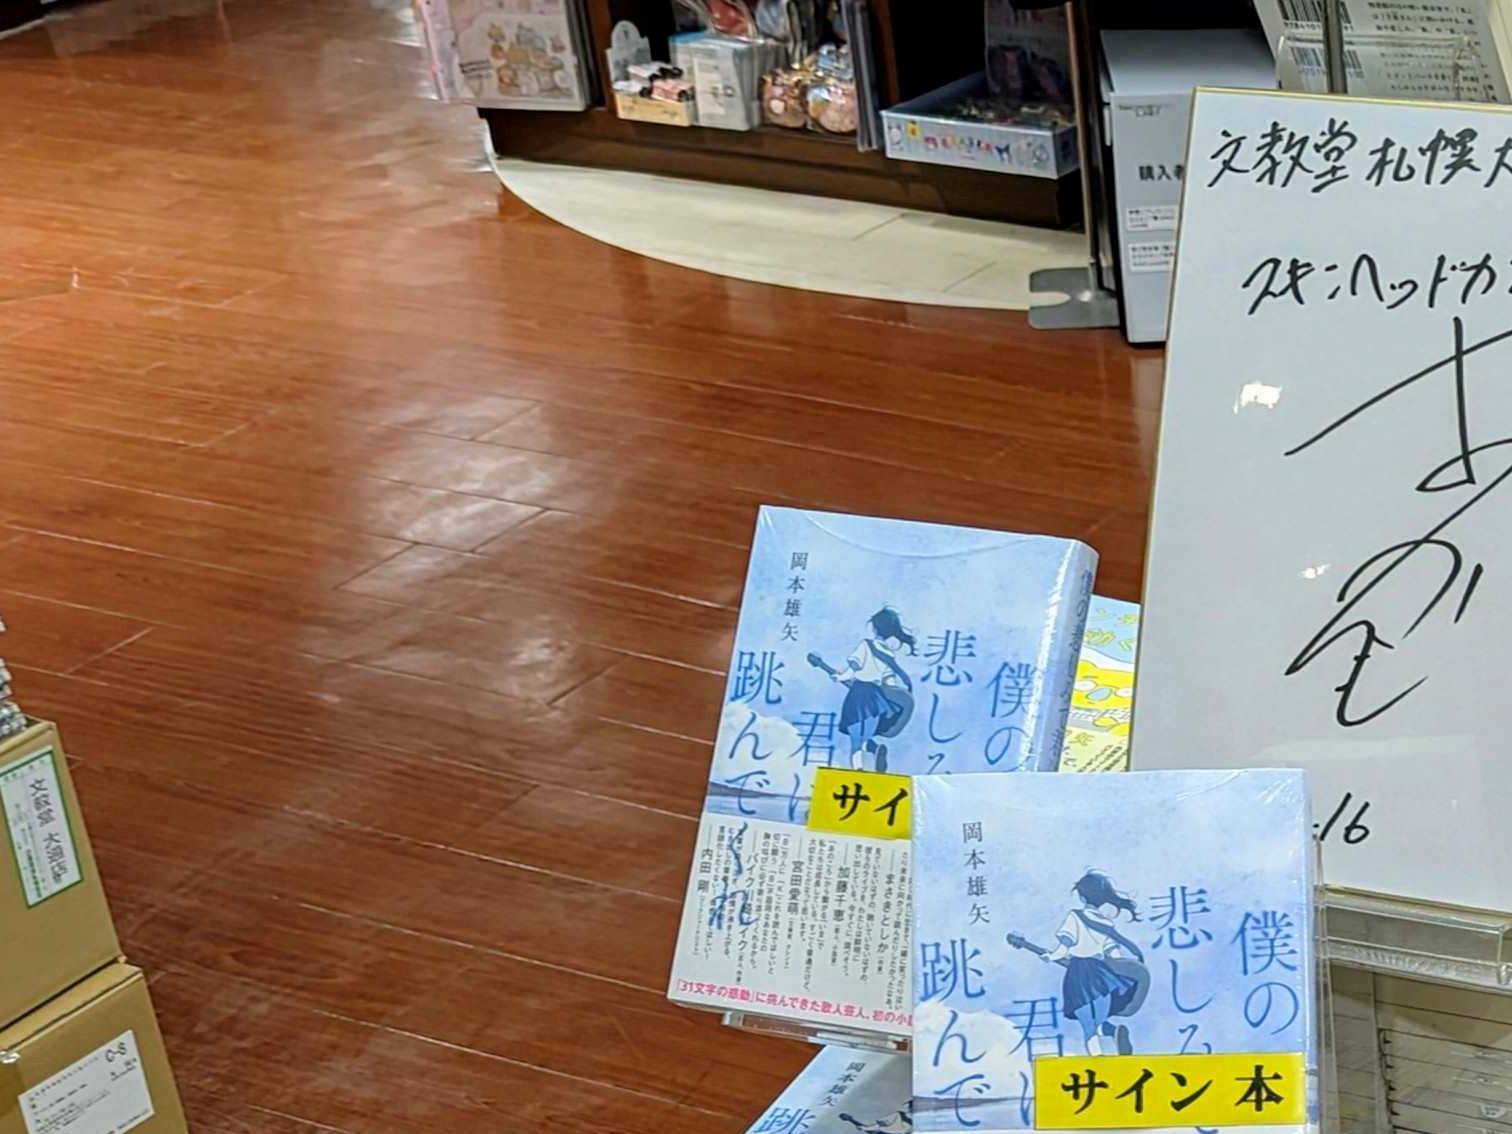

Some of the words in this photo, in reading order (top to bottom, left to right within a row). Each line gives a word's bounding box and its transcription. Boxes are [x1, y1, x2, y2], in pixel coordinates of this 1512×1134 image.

[781, 551, 810, 642] 岡本雄矢
[984, 660, 1045, 768] 僕の
[877, 873, 896, 954] まさきとしか
[961, 820, 992, 926] 岡本雄矢
[1231, 908, 1300, 1037] 僕の
[1059, 1064, 1285, 1116] サイン本
